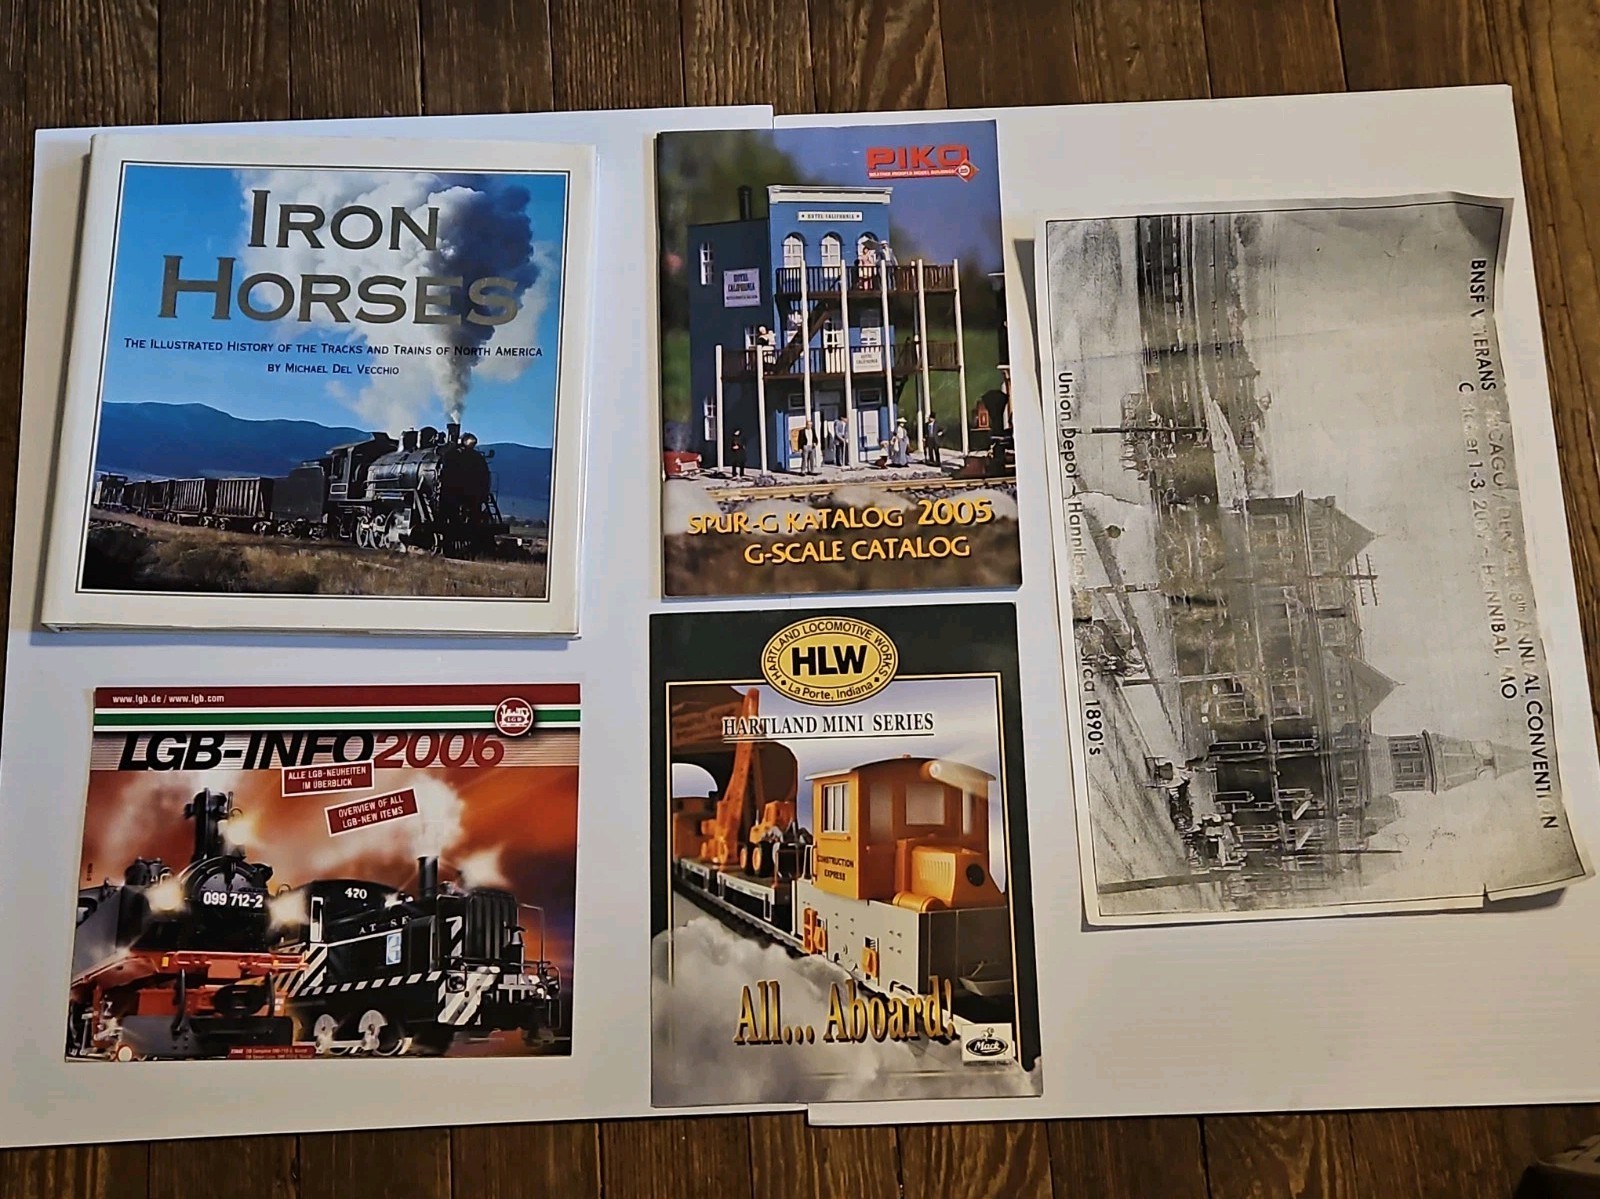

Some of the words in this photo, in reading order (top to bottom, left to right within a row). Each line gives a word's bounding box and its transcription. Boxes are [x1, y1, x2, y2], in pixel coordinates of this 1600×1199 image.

[866, 144, 970, 169] PIKO
[248, 189, 440, 251] IRON
[157, 255, 519, 326] HORSES
[1470, 259, 1487, 303] BNSF
[124, 337, 146, 349] THE
[150, 338, 223, 351] ILLUSTRATED
[227, 341, 274, 353] HISTORY
[277, 343, 293, 353] OF
[296, 344, 317, 353] THE
[321, 343, 363, 354] TRACKS
[367, 345, 389, 354] AND
[393, 344, 432, 356] TRAINS
[436, 346, 450, 356] OF
[454, 345, 491, 356] NORTH
[495, 345, 543, 357] AMERICA
[1470, 308, 1497, 391] VTERANS
[267, 363, 281, 373] BY
[285, 363, 328, 374] MICHAEL
[332, 363, 352, 374] DEL
[356, 364, 400, 375] VECCHIO
[1058, 372, 1074, 422] Union
[1061, 428, 1081, 479] Depot
[688, 512, 778, 535] SPUR-G
[786, 507, 903, 533] KATALOG
[918, 499, 995, 527] 2005
[744, 538, 846, 565] G-SCALE
[851, 536, 971, 562] CATALOG
[767, 629, 801, 681] HARTLAND
[802, 621, 874, 640] LOCOMOTIVE
[873, 635, 893, 677] WORKS
[791, 645, 868, 676] HLW
[112, 694, 161, 705] www.lgb.de
[169, 694, 225, 704] www.lgb.com
[788, 682, 801, 694] La
[802, 688, 835, 701] Porte,
[836, 681, 874, 699] Indiana
[721, 714, 818, 736] HARTLAND
[822, 714, 865, 733] MINI
[872, 712, 935, 731] SERIES
[1084, 700, 1105, 756] 1890's
[288, 769, 306, 780] ALLE
[308, 766, 367, 779] LGB-NEUHEITEN
[1526, 700, 1559, 829] CONVENTIN
[302, 781, 311, 790] IM
[338, 802, 376, 818] OVERVIEW
[378, 799, 389, 808] OF
[389, 795, 404, 805] ALL
[342, 813, 378, 828] LGB-NEW
[379, 806, 404, 820] ITEMS
[203, 891, 227, 906] 099
[230, 892, 264, 908] 712-2
[344, 887, 368, 900] 470
[824, 975, 960, 1043] Aboard!
[973, 1041, 1001, 1052] Mack
